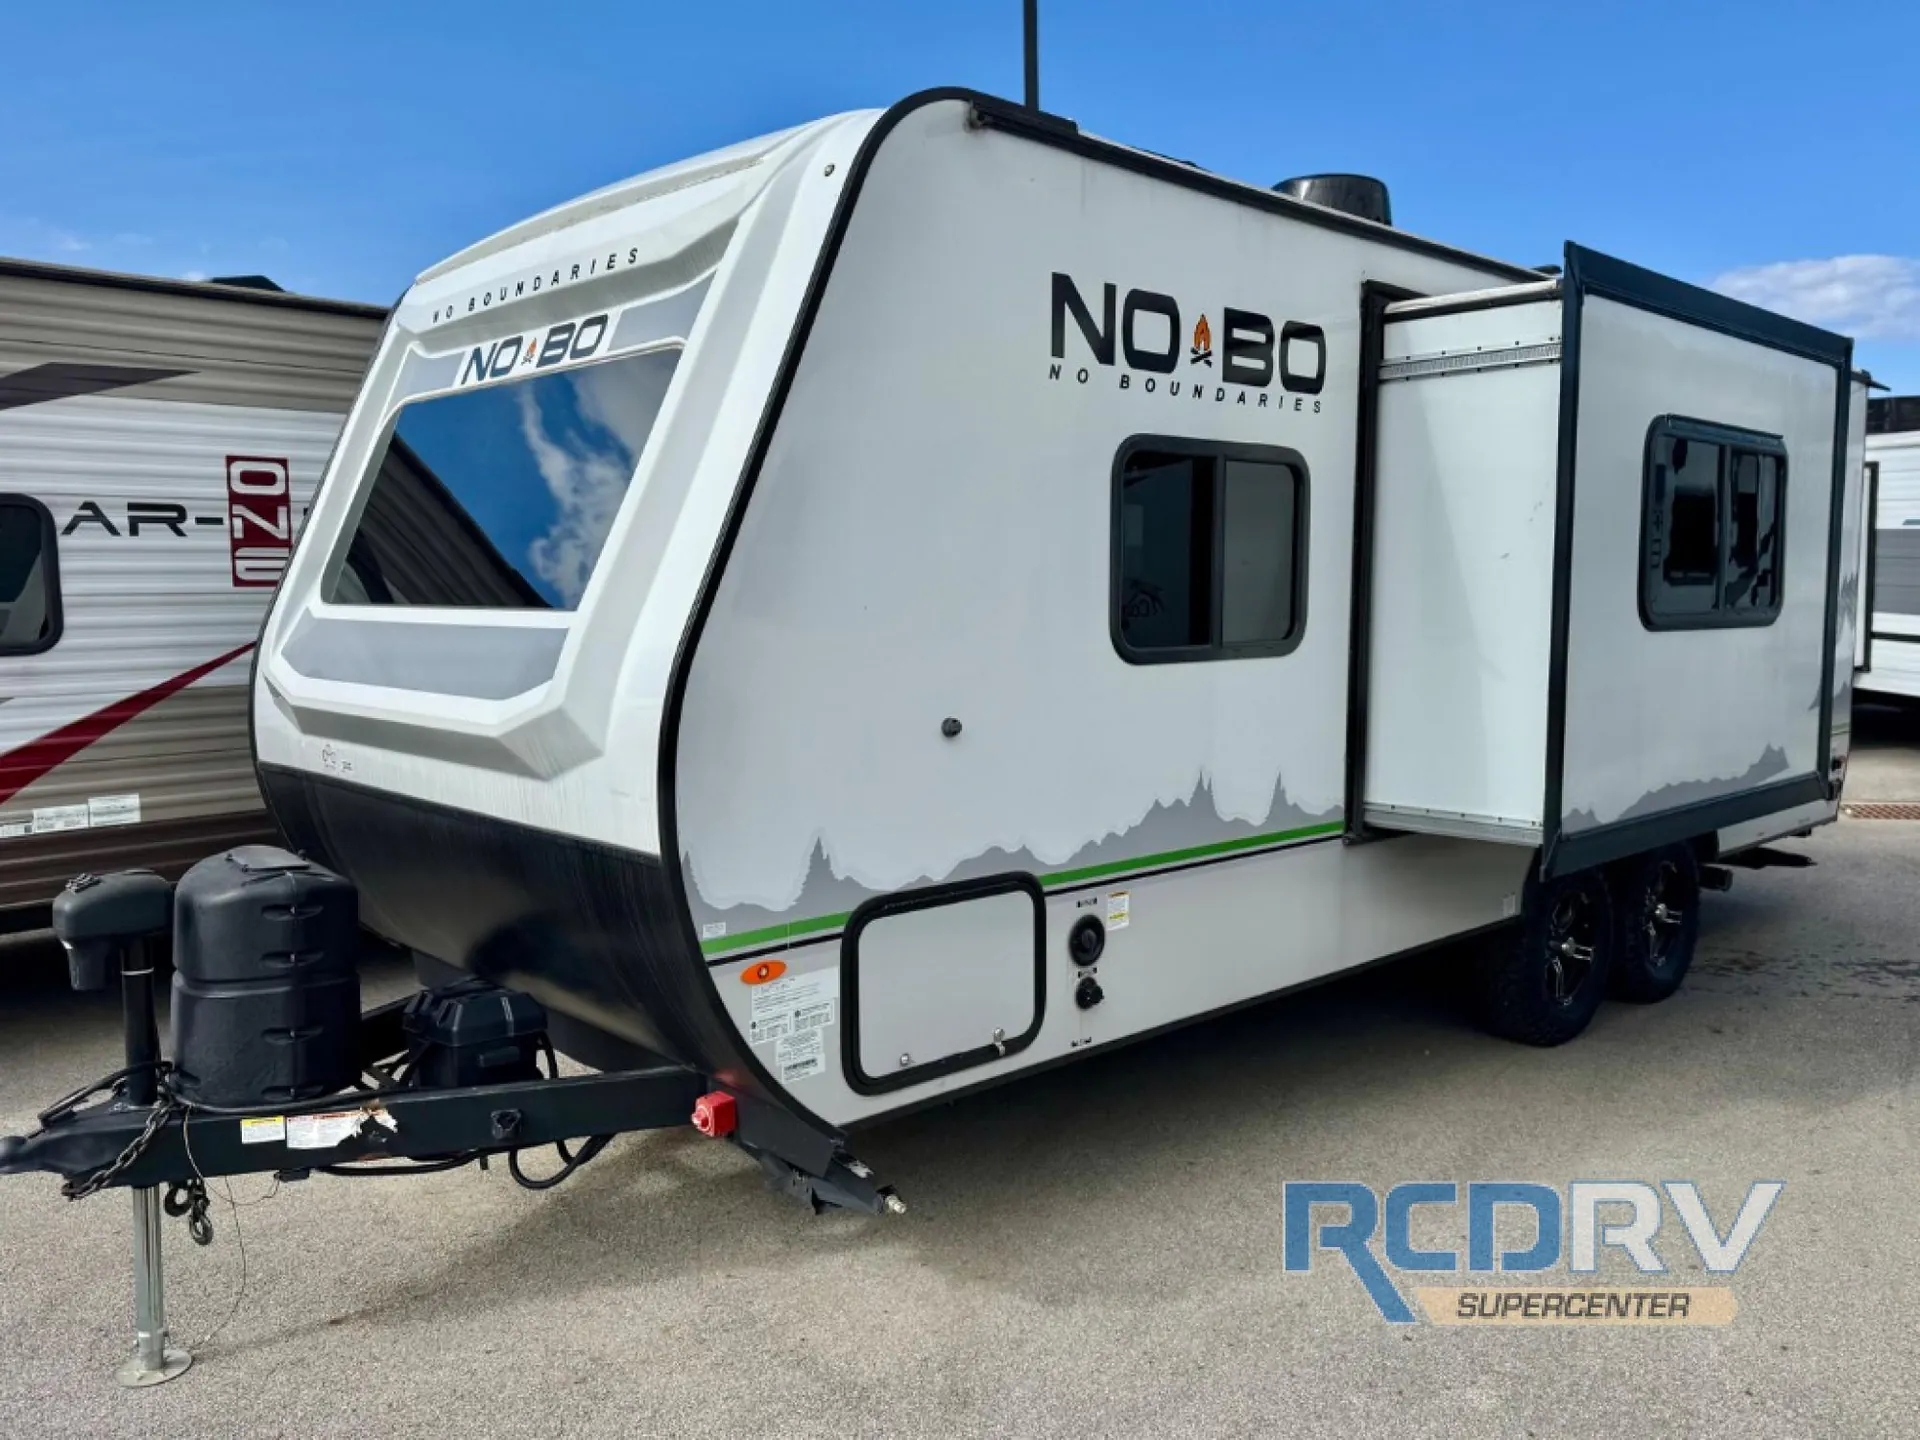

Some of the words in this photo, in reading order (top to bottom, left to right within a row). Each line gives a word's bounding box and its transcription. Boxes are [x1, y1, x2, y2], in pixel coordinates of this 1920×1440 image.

[432, 304, 454, 324] NO
[468, 247, 638, 312] BOUNDARIES
[1048, 363, 1089, 384] NO
[1118, 373, 1322, 414] BOUNDARIES
